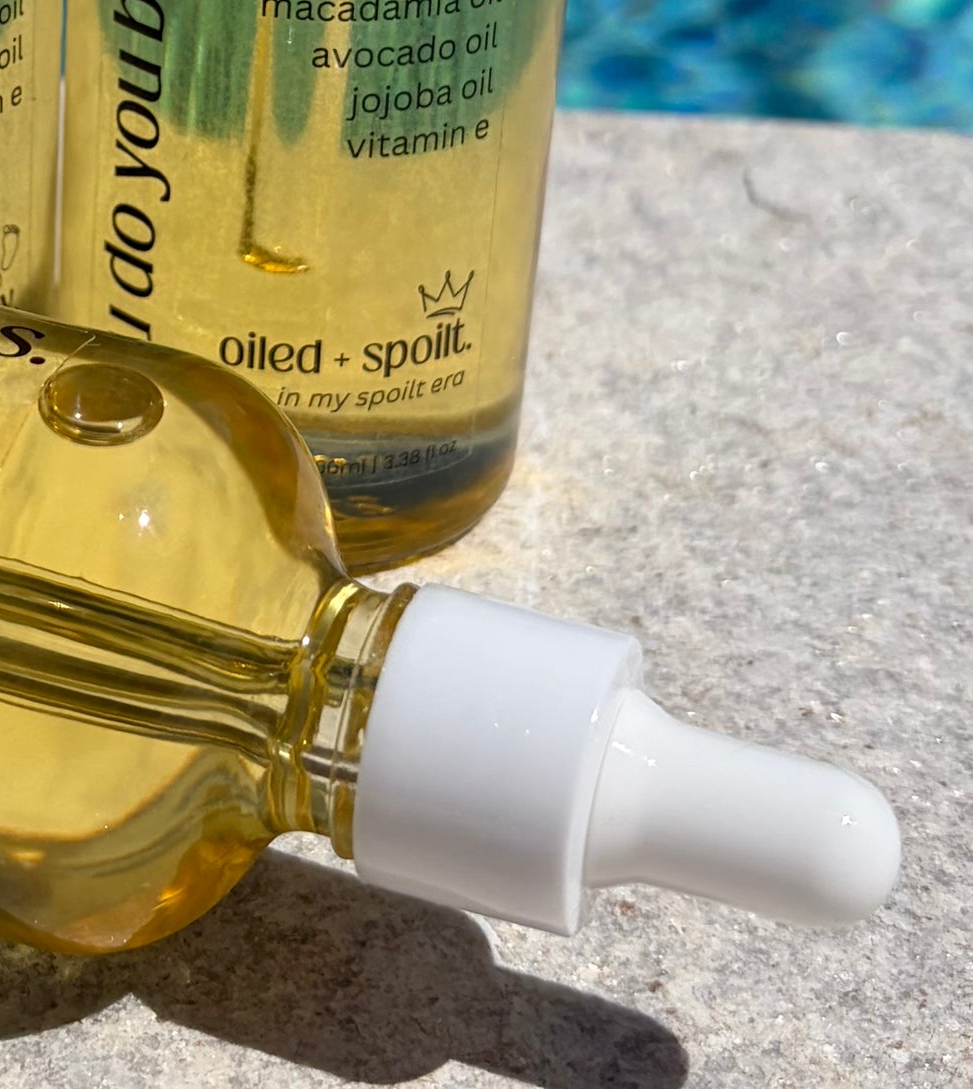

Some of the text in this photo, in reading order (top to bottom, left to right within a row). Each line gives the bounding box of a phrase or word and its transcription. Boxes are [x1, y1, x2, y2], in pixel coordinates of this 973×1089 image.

[311, 22, 498, 69] avocado oil
[10, 85, 23, 106] e
[346, 67, 494, 122] jojoba oil
[114, 49, 171, 202] you
[347, 118, 489, 159] vitamin e
[104, 202, 157, 299] do
[219, 316, 474, 378] oiled + spoilt.
[277, 368, 467, 413] in my spoilt era
